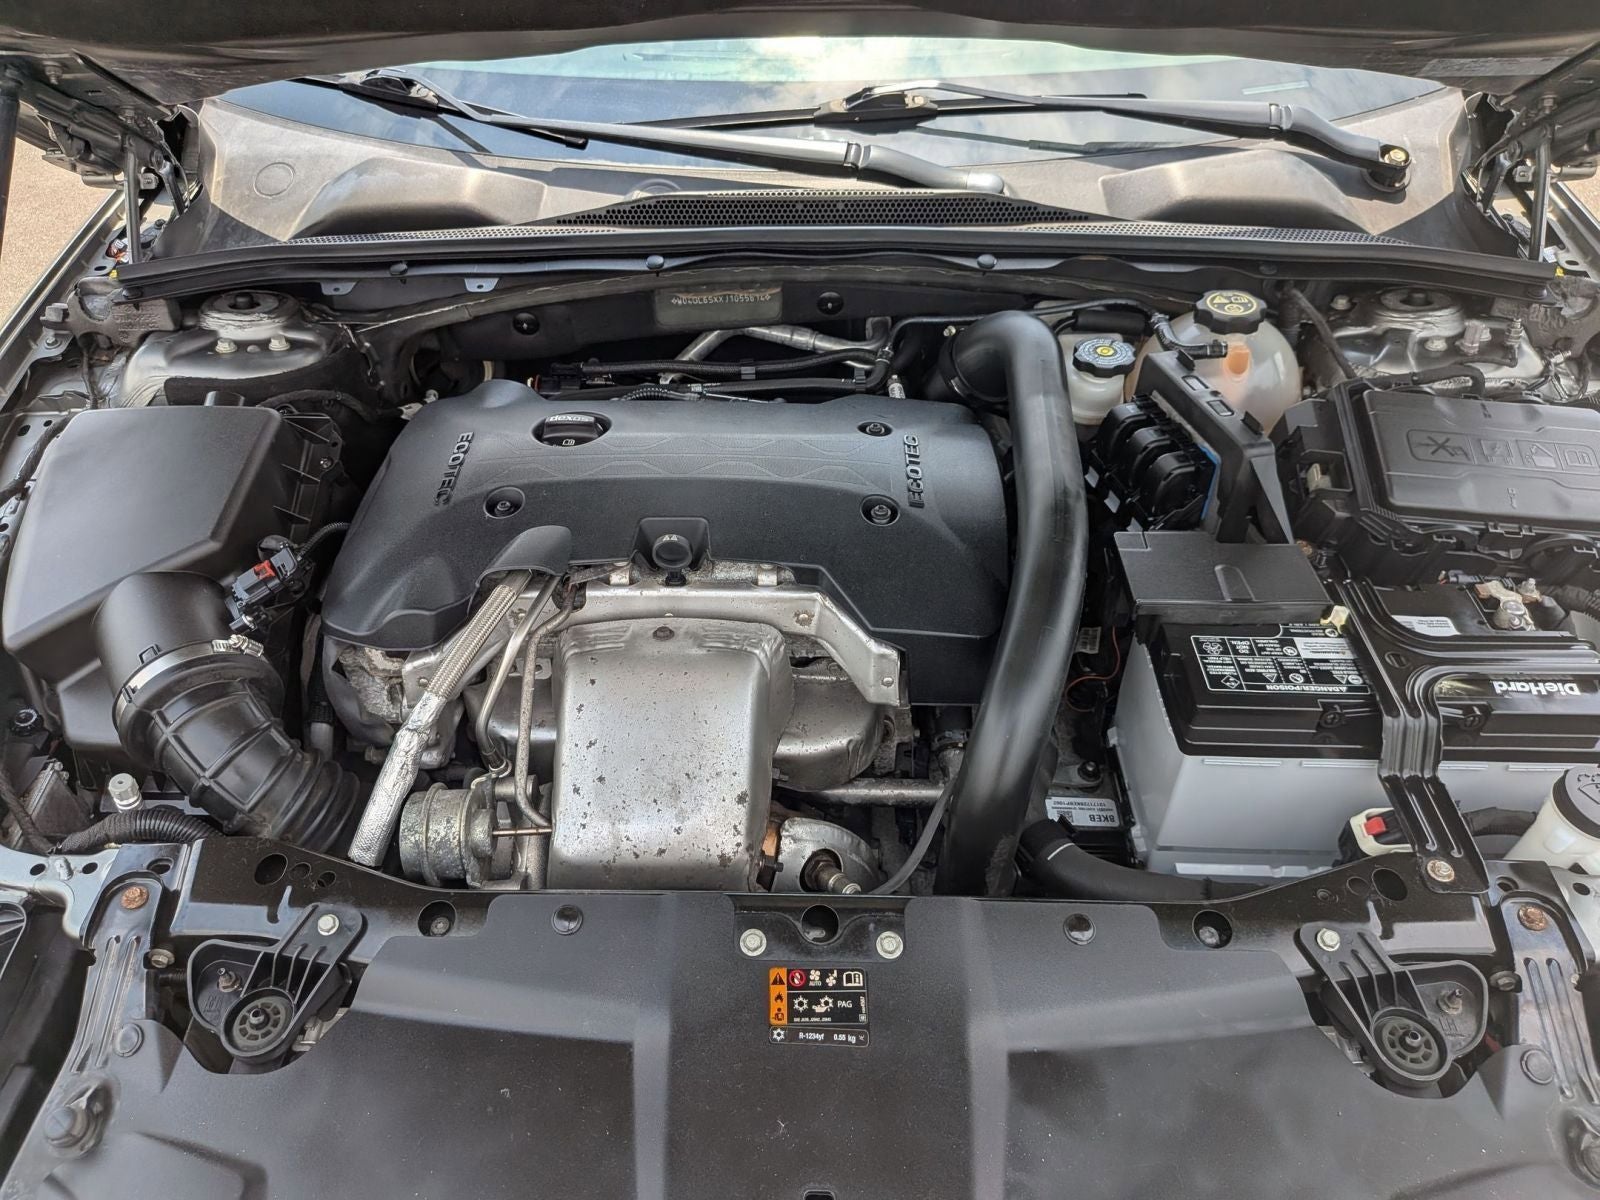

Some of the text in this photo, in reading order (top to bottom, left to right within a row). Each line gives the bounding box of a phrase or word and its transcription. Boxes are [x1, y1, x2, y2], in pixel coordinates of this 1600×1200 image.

[434, 431, 474, 505] ECOTEC
[904, 434, 925, 508] ECOTEC
[1493, 681, 1581, 696] DieHard
[1088, 814, 1115, 823] 8KEB
[837, 1000, 853, 1008] PAG
[798, 1032, 825, 1041] R-1234yf
[847, 1034, 856, 1044] kg
